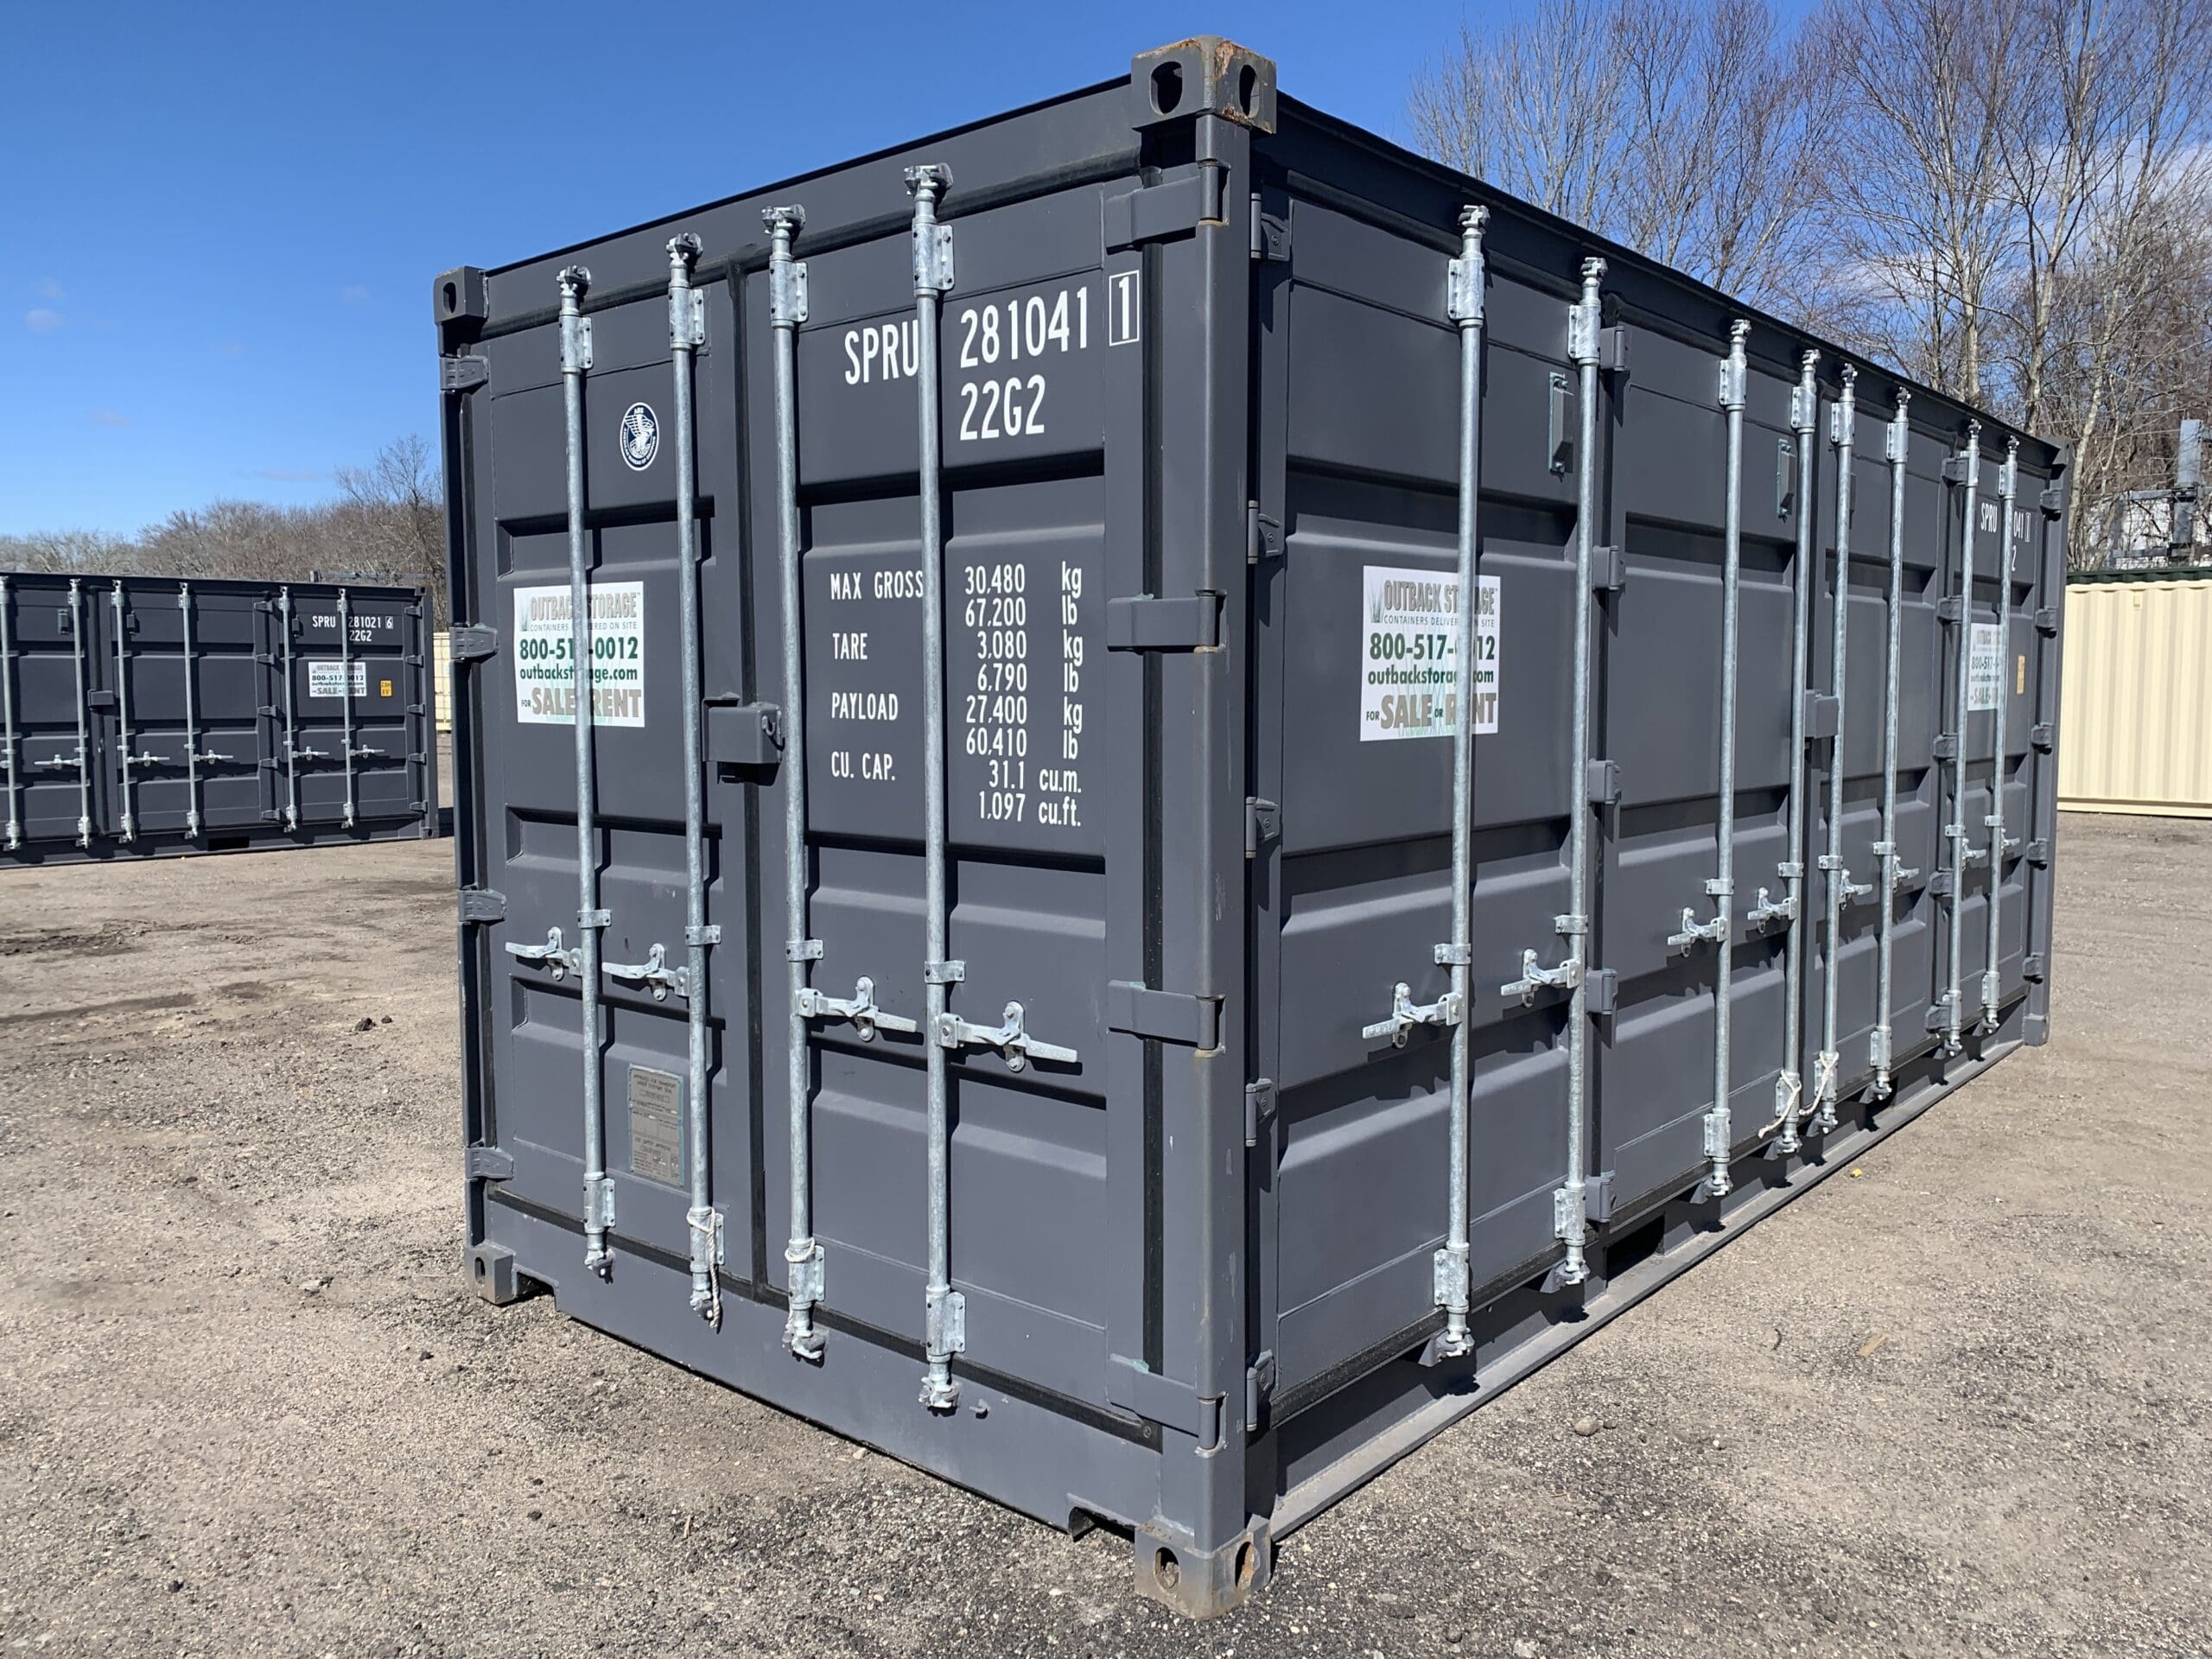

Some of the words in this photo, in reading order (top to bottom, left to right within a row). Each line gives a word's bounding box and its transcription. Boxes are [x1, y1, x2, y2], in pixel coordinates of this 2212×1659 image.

[844, 319, 918, 385] SPRU
[960, 286, 1087, 369] 281041
[959, 374, 1046, 441] 22G2
[1980, 502, 1998, 533] SPRU
[830, 572, 862, 601] MAX
[874, 570, 923, 599] GROSS
[964, 563, 1026, 595] 30,480
[1061, 561, 1082, 598] kg
[1383, 580, 1442, 613] OUTBACK
[312, 615, 336, 628] SPRU
[348, 615, 381, 629] 281021
[531, 595, 572, 620] OUTBAC
[965, 596, 1027, 627] 67,200
[1062, 595, 1077, 625] lb
[1383, 614, 1428, 626] CONTAINERS
[1481, 619, 1495, 628] SITE
[349, 630, 372, 642] 22G2
[530, 623, 569, 632] CONTAINERS
[519, 637, 639, 660] 800-51-0012
[832, 632, 868, 660] TARE
[977, 630, 1027, 659] 3,080
[1064, 629, 1084, 666] kg
[1369, 632, 1496, 661] 800-517-12
[977, 663, 1027, 692] 6,790
[1064, 663, 1079, 692] lb
[1367, 664, 1494, 688] outbackstoracom
[531, 687, 575, 715] SALE
[831, 692, 899, 721] PAYLOAD
[966, 695, 1027, 725] 27,400
[1064, 696, 1083, 734] kg
[1366, 710, 1380, 721] FOR
[1380, 694, 1433, 730] SALE
[1434, 709, 1443, 718] OR
[1445, 693, 1497, 725] RNT
[966, 727, 1027, 758] 60,410
[1063, 730, 1078, 760] lb
[831, 751, 855, 779] CU.
[861, 753, 896, 781] CAP.
[988, 759, 1025, 790] 31.1
[979, 791, 1026, 822] 1,097
